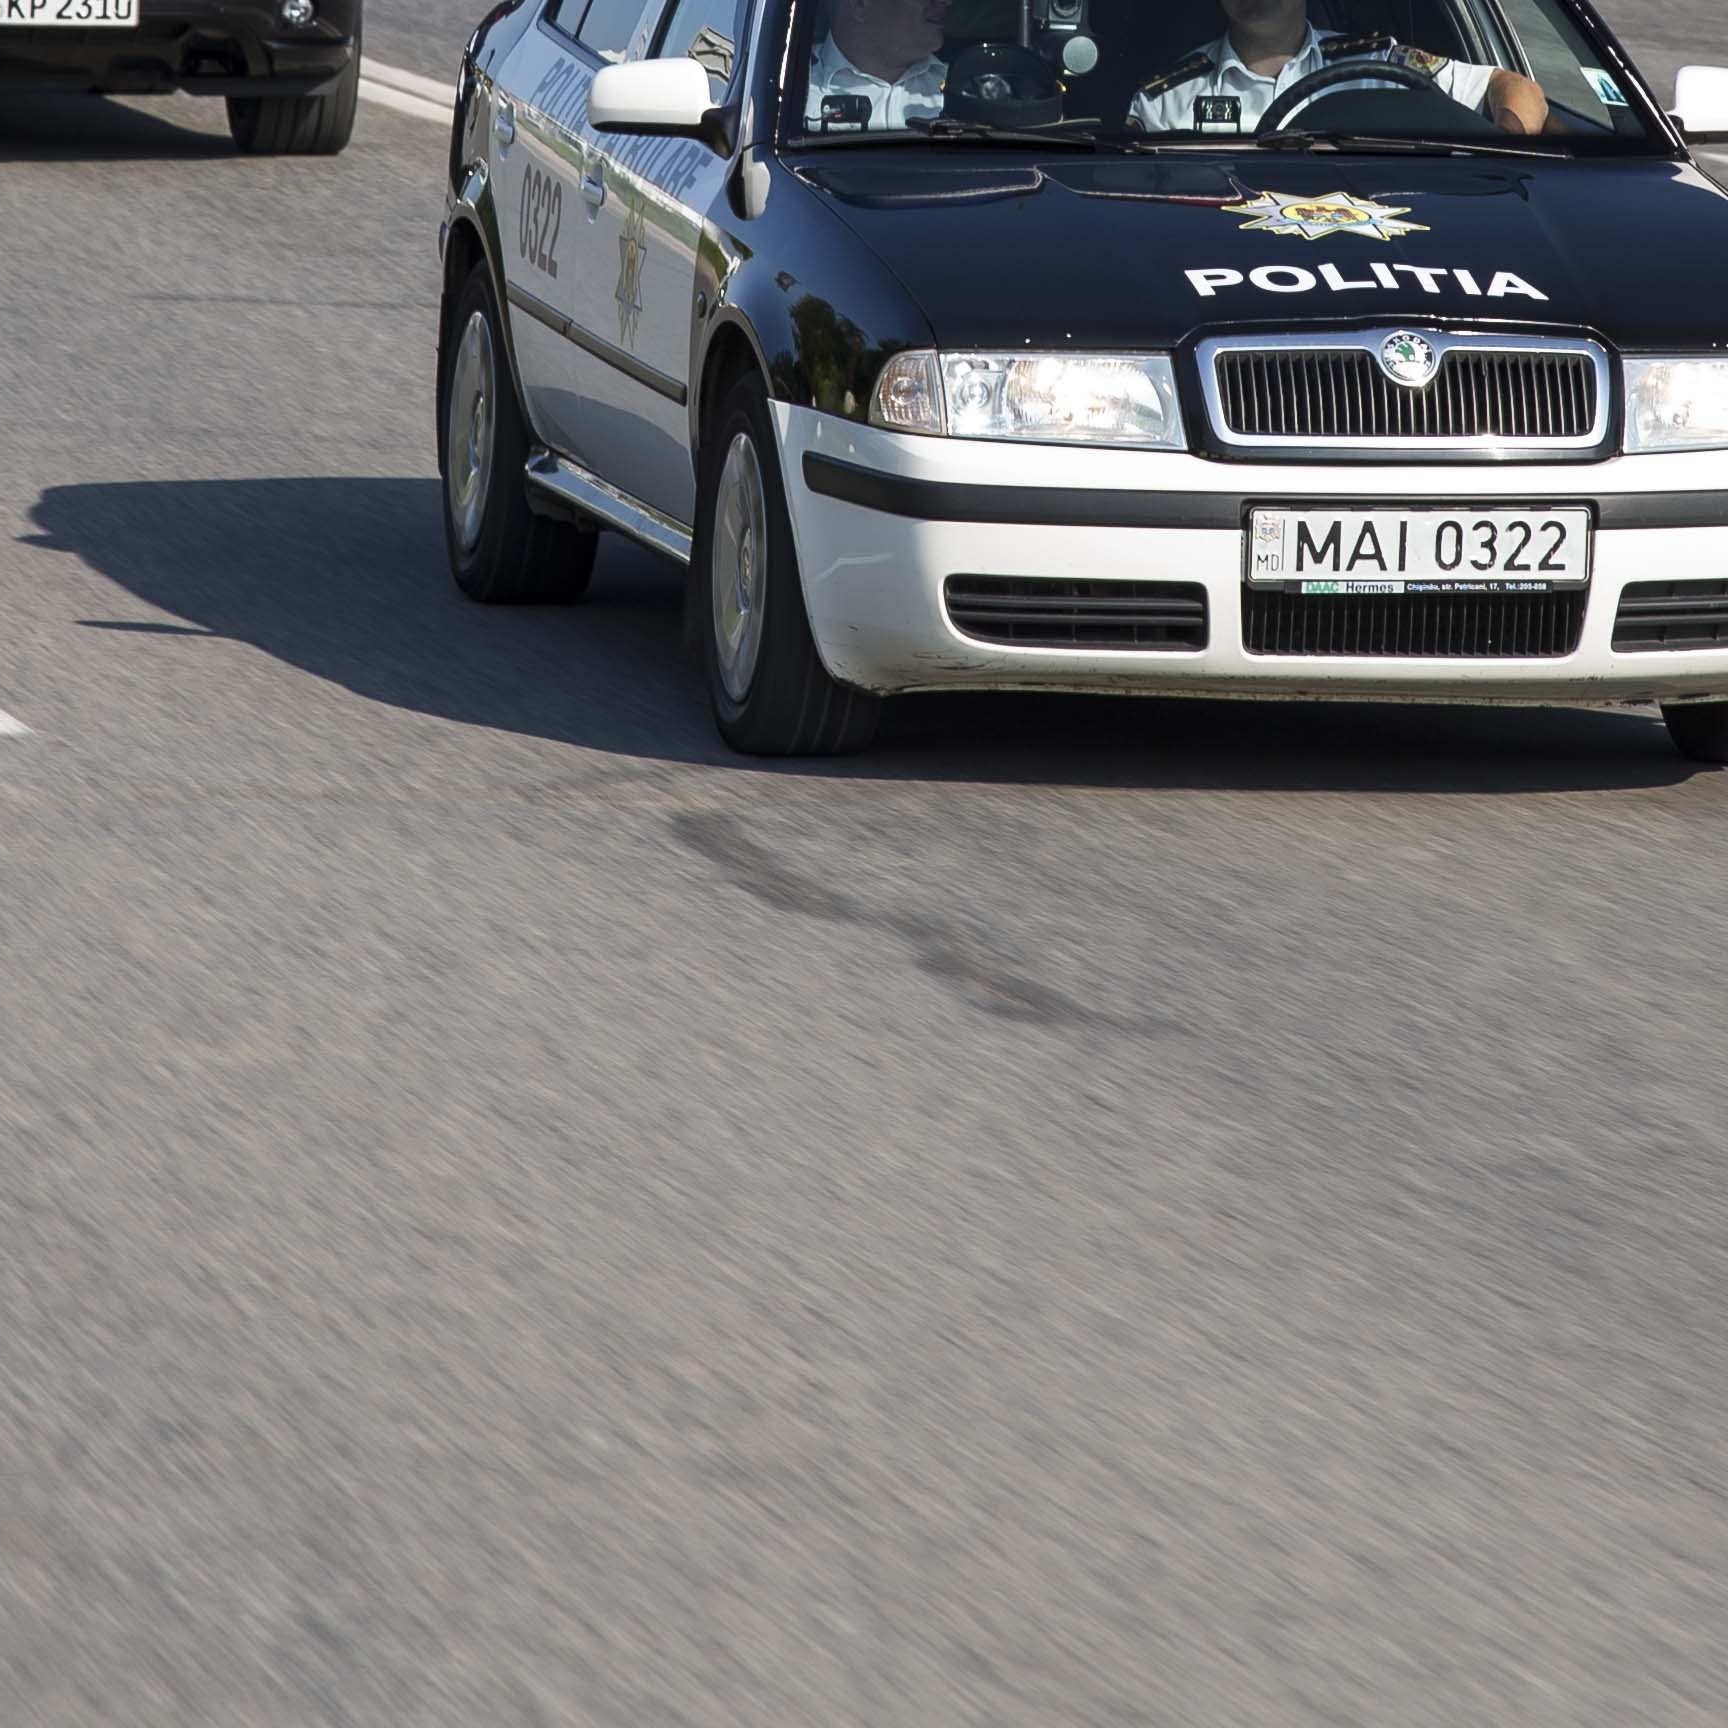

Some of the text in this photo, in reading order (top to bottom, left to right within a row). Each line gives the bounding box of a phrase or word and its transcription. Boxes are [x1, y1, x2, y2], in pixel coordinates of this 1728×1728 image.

[519, 163, 562, 280] 0322
[1184, 262, 1550, 301] POLITIA
[1256, 554, 1280, 573] MD
[1296, 520, 1567, 572] MAI 0322
[1345, 581, 1394, 593] Hermes
